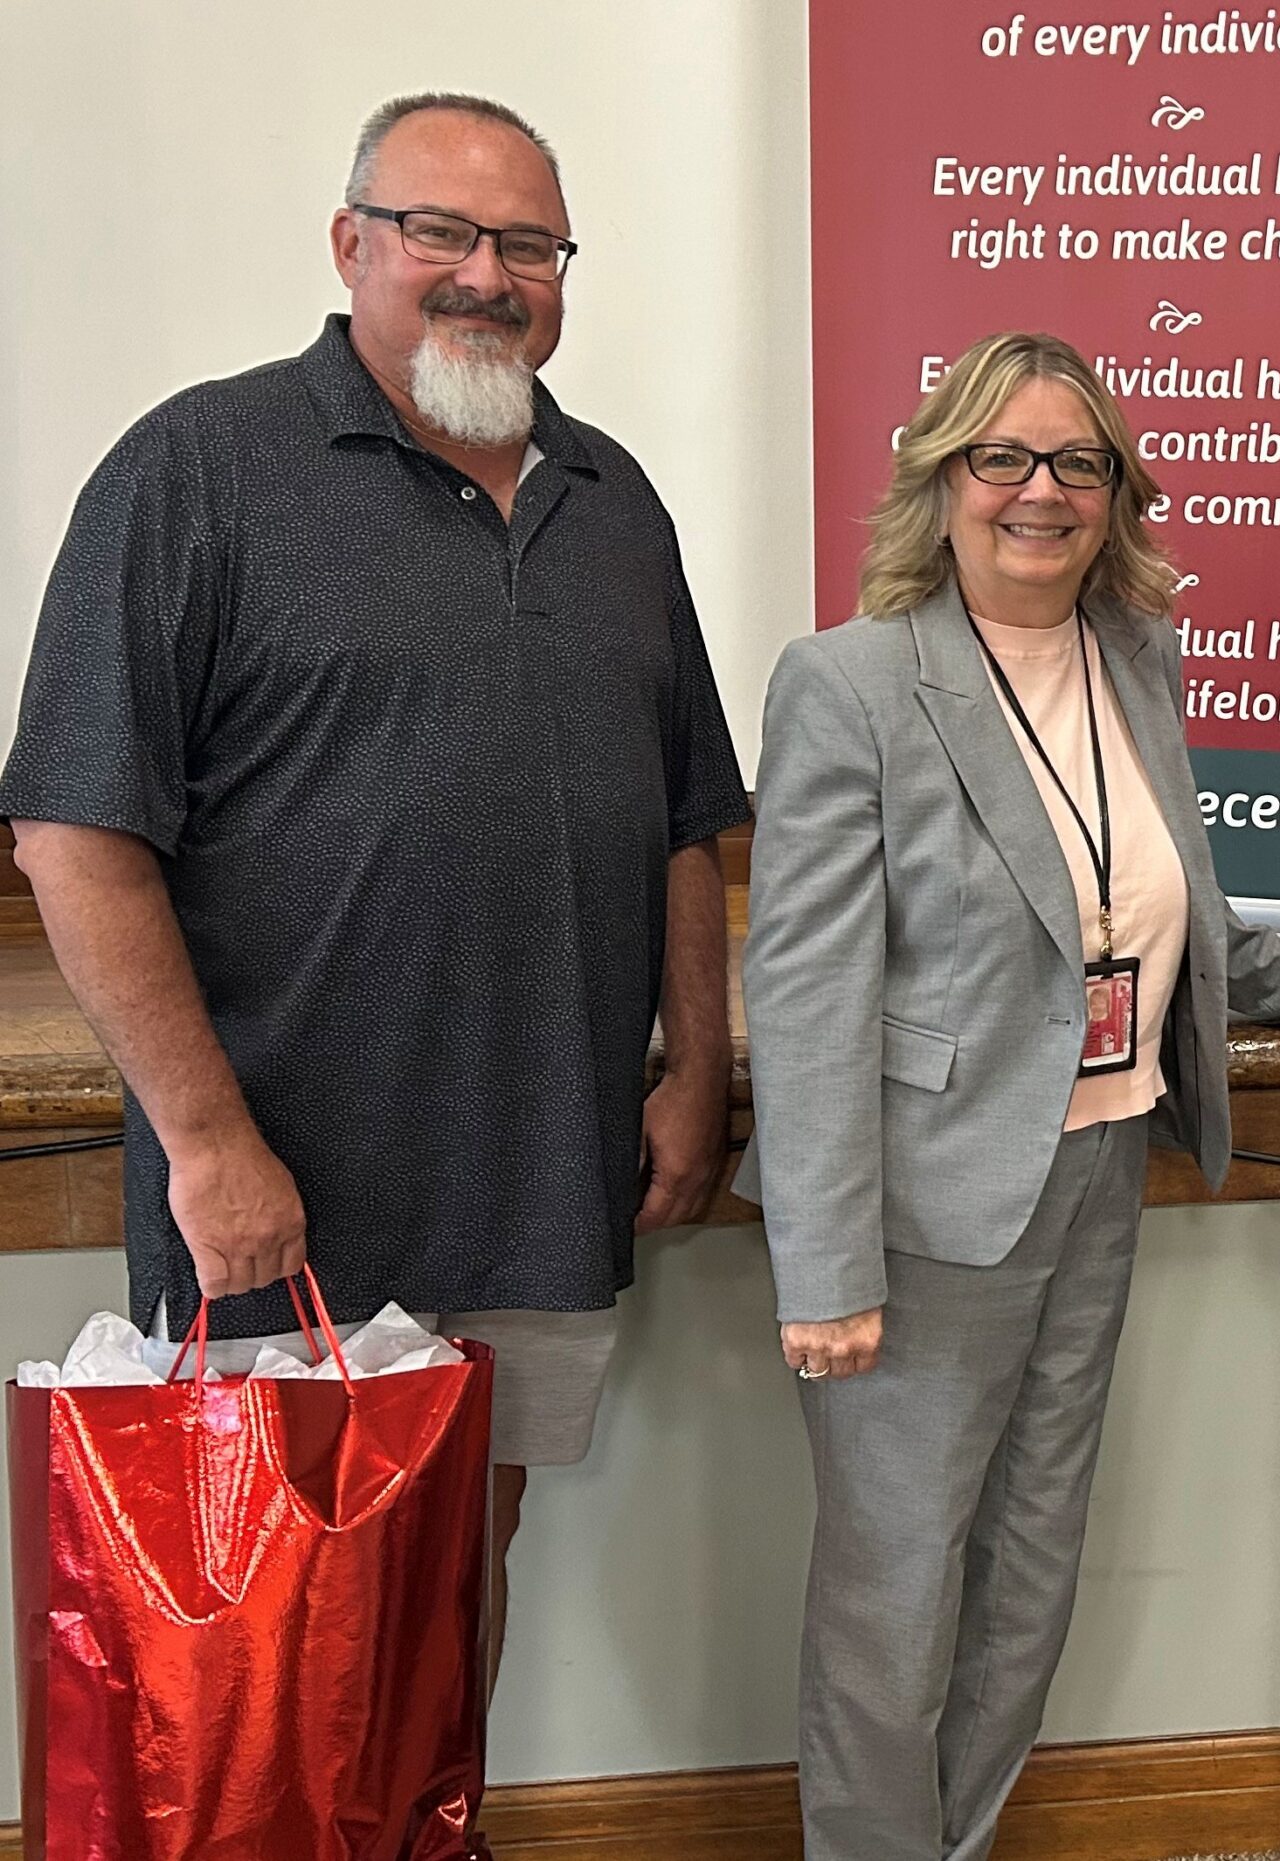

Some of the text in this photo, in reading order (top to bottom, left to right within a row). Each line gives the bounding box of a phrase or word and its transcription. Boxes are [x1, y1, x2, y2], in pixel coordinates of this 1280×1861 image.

[982, 14, 1024, 57] of
[1034, 24, 1150, 66] every
[933, 157, 1045, 206] Every
[1055, 153, 1262, 196] individual
[951, 219, 1046, 270] right
[1058, 223, 1099, 260] to
[1112, 218, 1228, 261] make
